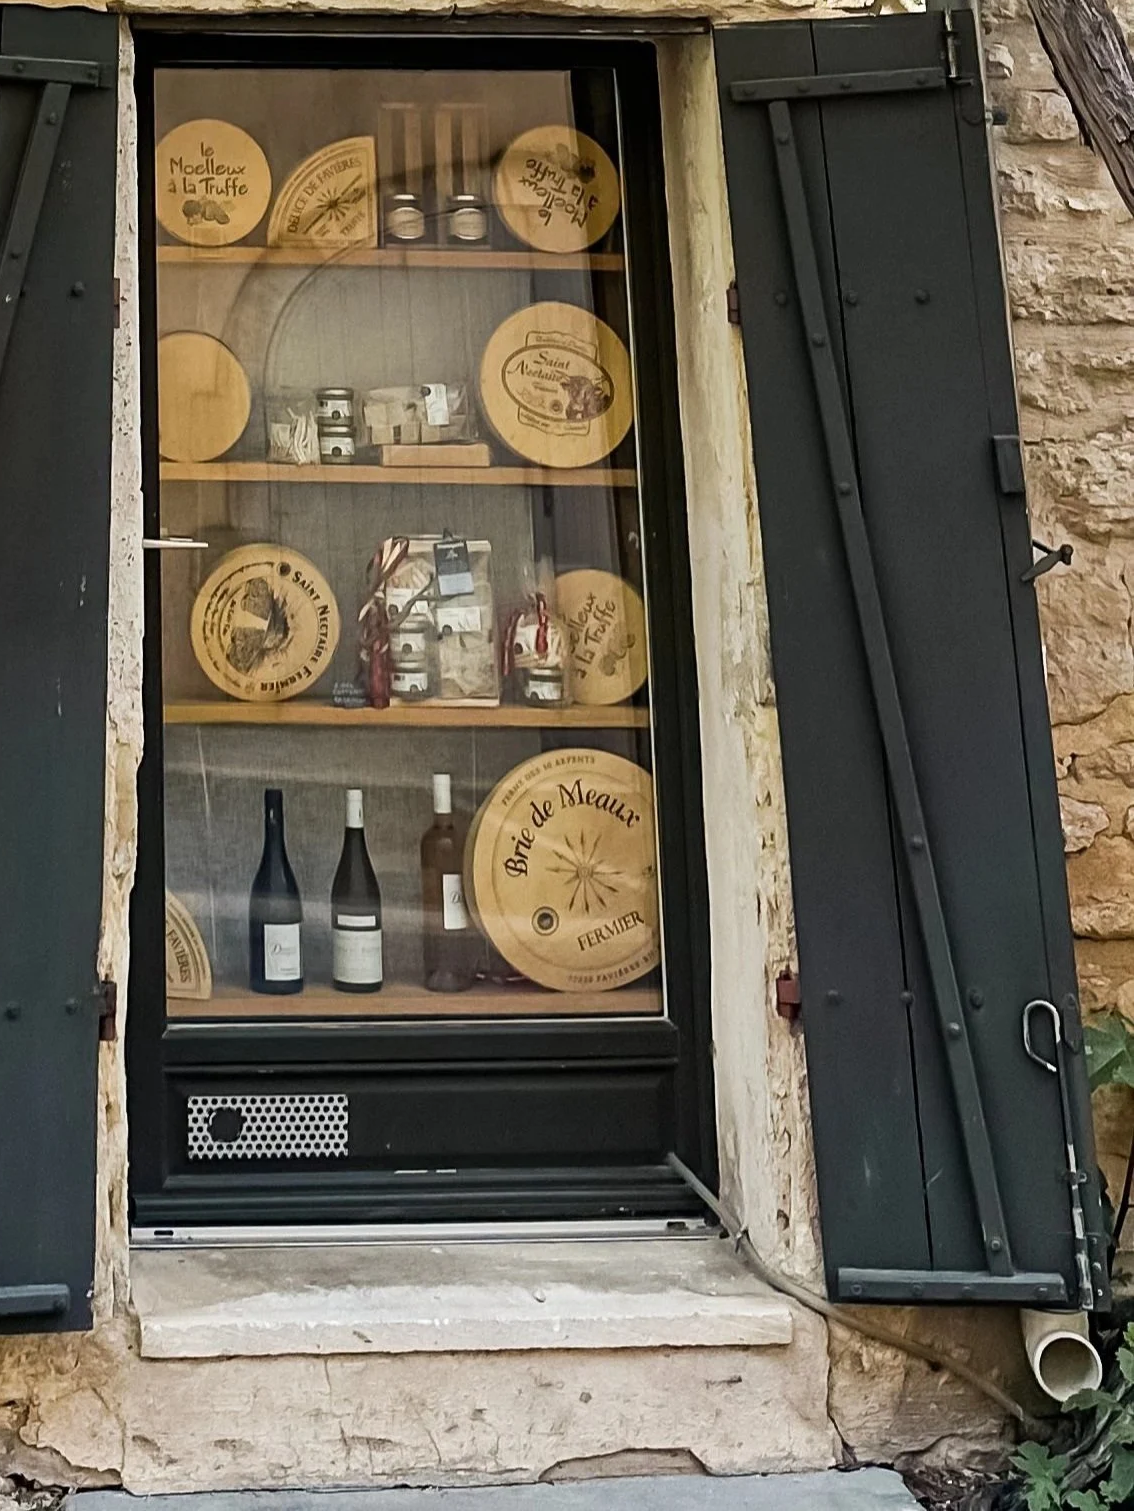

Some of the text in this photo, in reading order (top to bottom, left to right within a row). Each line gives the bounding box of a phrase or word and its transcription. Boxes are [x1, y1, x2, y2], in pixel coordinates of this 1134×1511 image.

[200, 141, 215, 157] le
[169, 156, 247, 176] Moelleux
[526, 158, 567, 195] Truffe
[168, 177, 249, 197] à la Truffe
[571, 184, 585, 206] la
[518, 176, 588, 229] Moelleux
[538, 209, 552, 227] le
[533, 350, 571, 370] Saint
[584, 599, 616, 646] Truffe
[503, 778, 641, 878] Brie de Meaux
[576, 909, 645, 953] FERMIER
